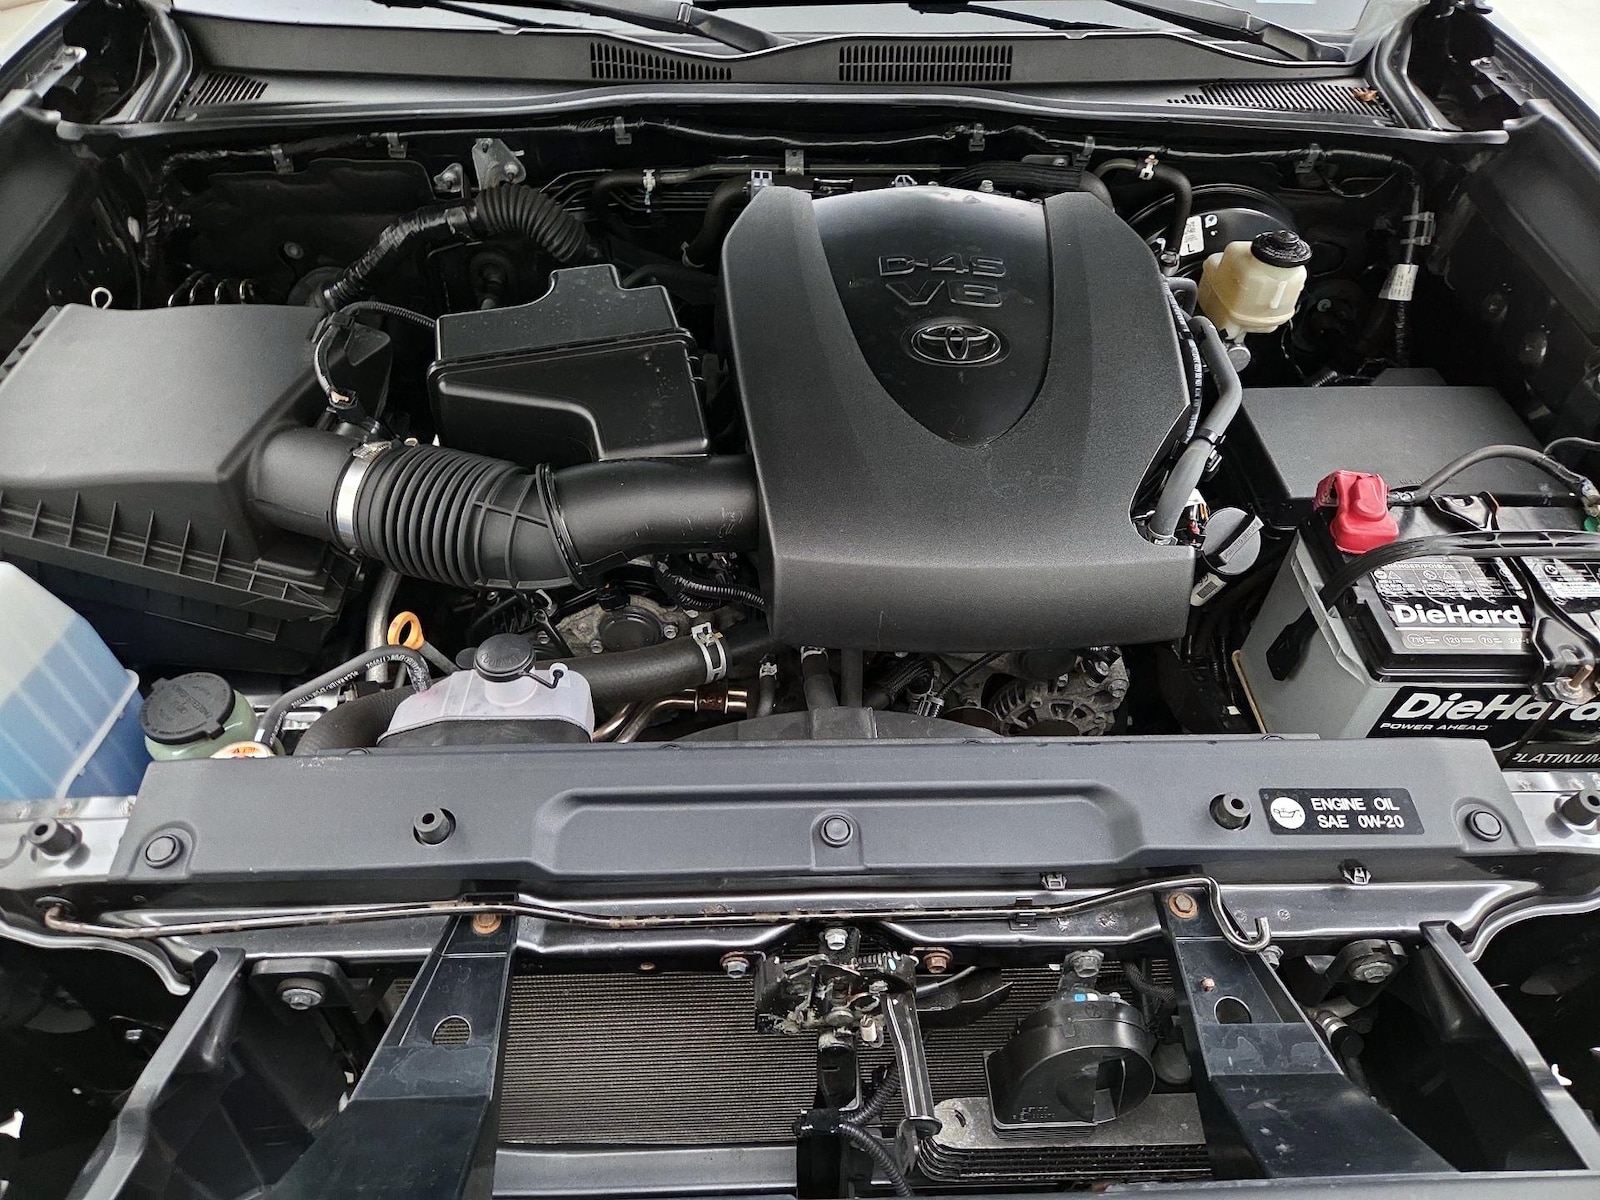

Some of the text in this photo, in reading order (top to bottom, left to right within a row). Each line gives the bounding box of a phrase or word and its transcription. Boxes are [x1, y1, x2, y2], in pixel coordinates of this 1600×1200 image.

[878, 252, 1007, 278] D-4S
[885, 279, 1003, 308] V6
[1392, 604, 1527, 625] DieHard
[1392, 692, 1600, 721] DieHard
[1380, 723, 1434, 731] POWER
[1310, 797, 1400, 811] ENGINE OIL
[1317, 814, 1405, 828] SAE 0W-20
